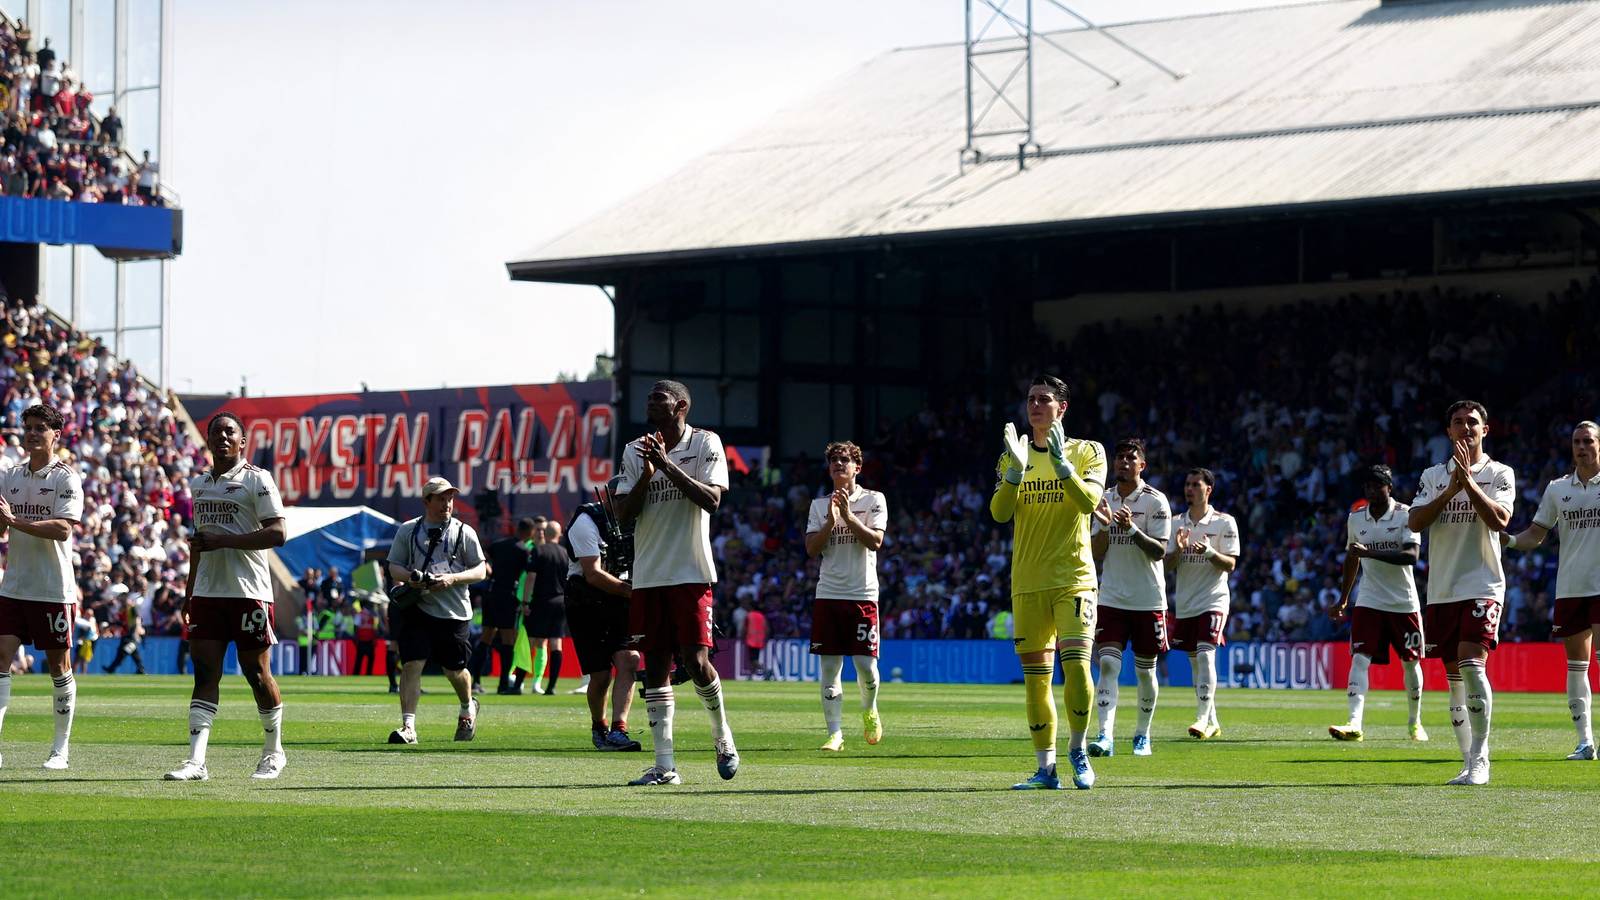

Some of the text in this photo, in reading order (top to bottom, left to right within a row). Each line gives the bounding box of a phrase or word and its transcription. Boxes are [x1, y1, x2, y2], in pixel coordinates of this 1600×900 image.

[247, 411, 431, 500] CRYSTAL
[1024, 492, 1065, 504] FLY BETTER
[1451, 512, 1477, 523] BETTER
[1074, 597, 1094, 620] 13
[46, 611, 69, 633] 16
[241, 608, 267, 633] 49
[856, 623, 877, 642] 56
[1403, 631, 1421, 649] 20
